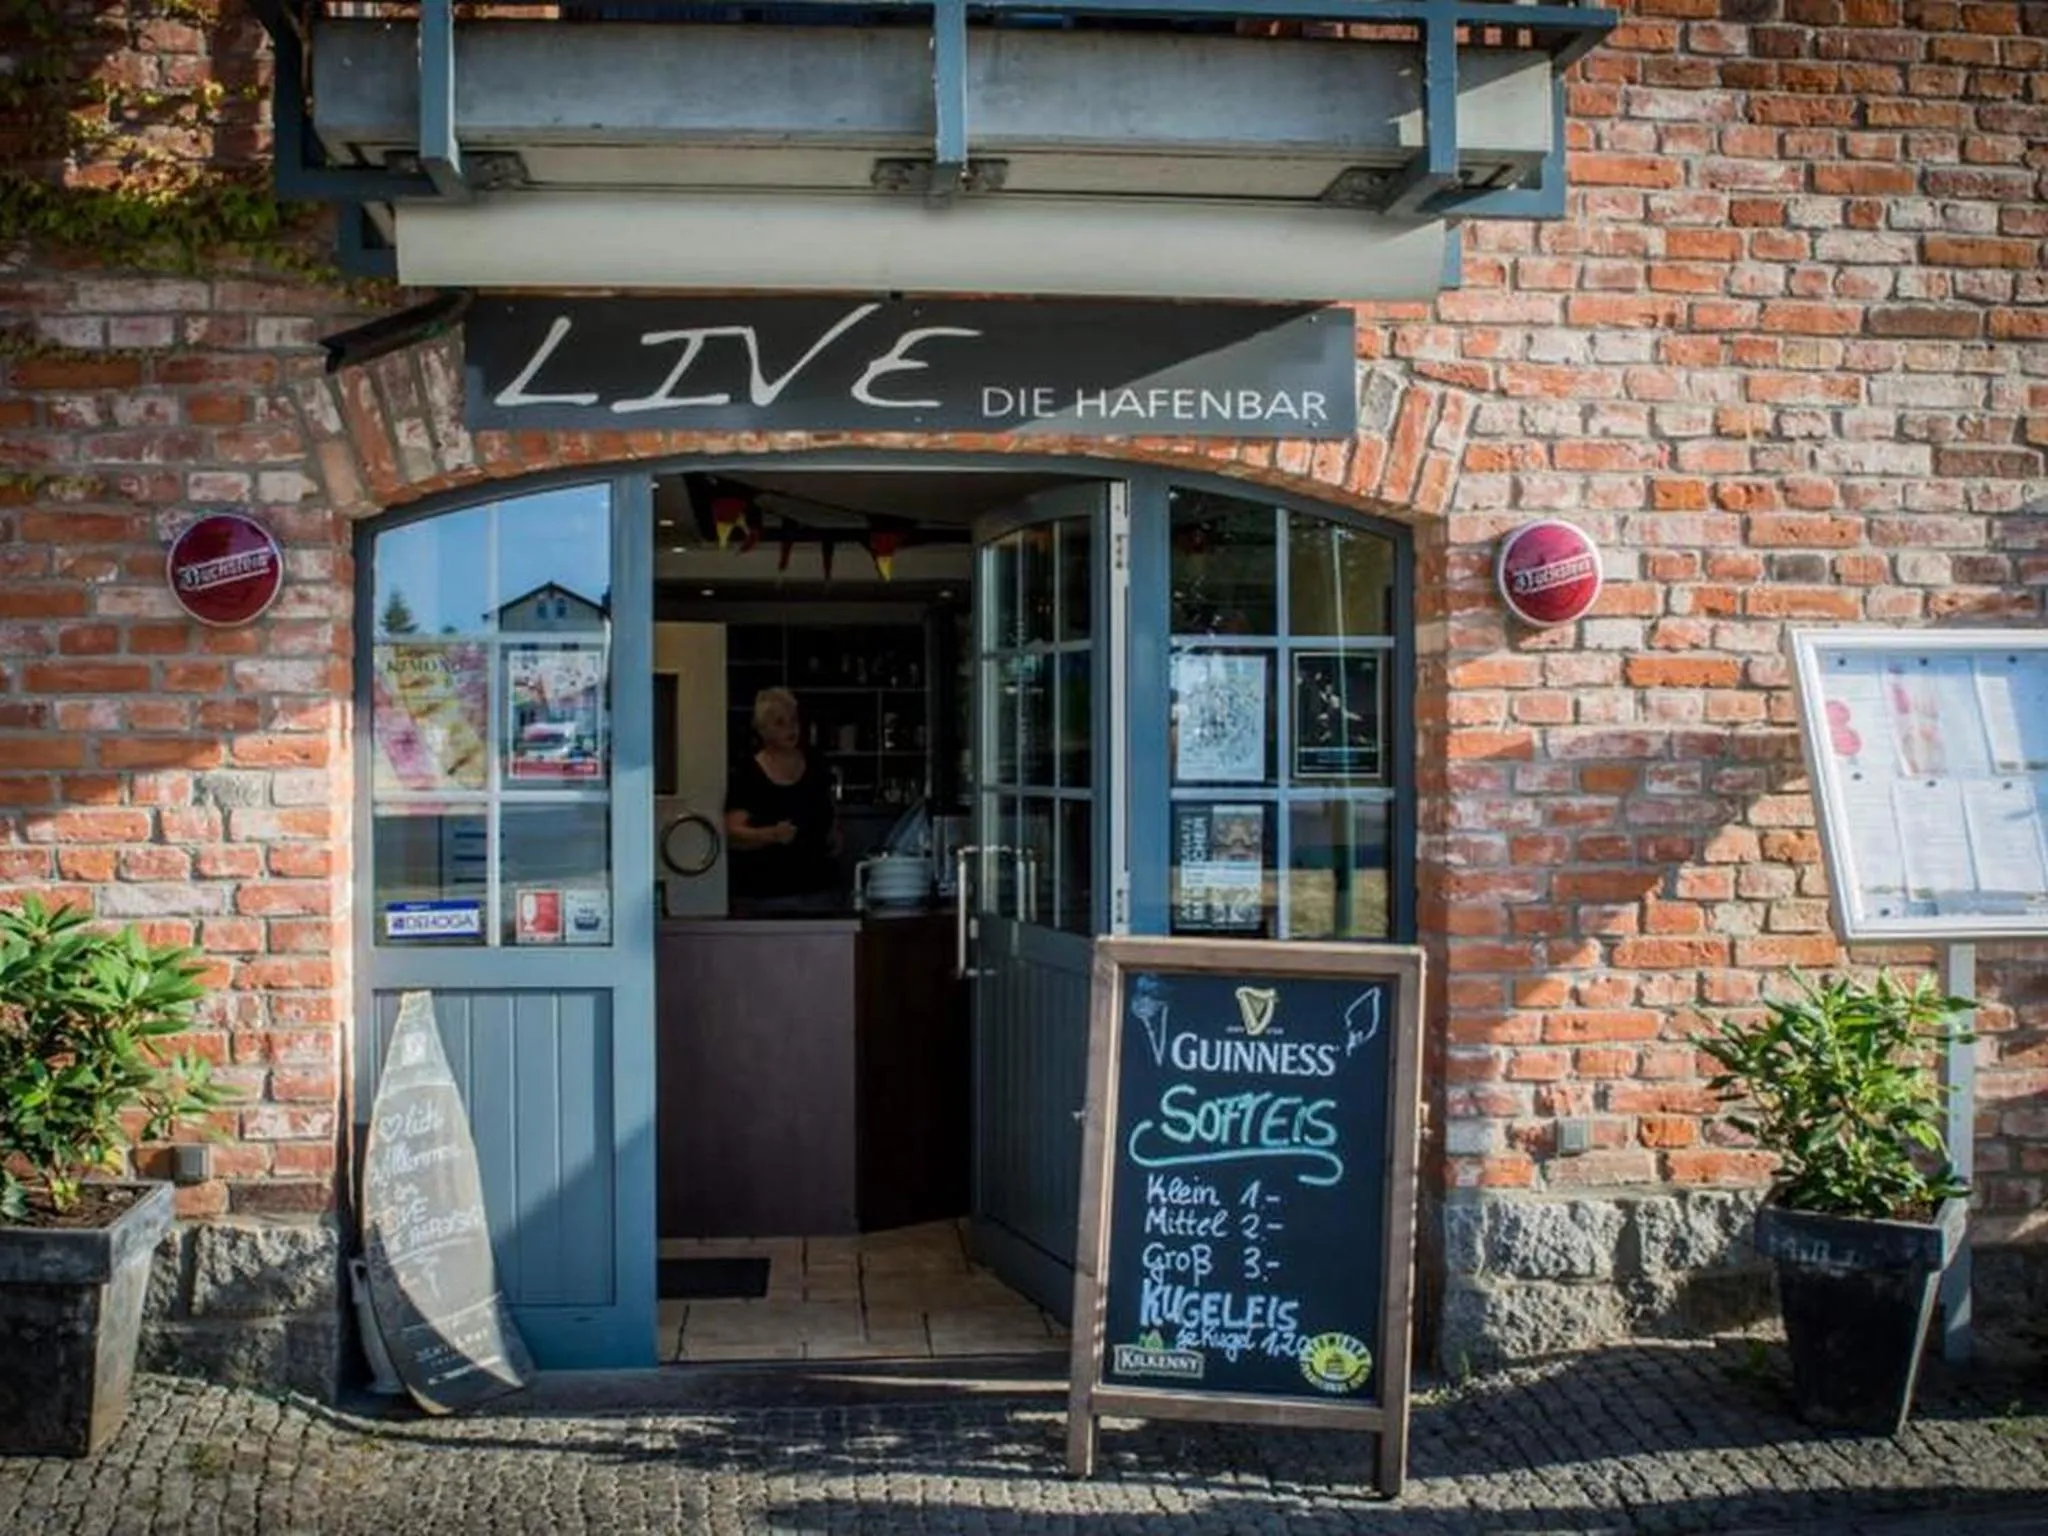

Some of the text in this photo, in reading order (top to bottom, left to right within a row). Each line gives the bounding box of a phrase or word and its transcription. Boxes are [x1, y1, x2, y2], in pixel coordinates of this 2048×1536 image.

[494, 302, 1329, 422] LIVE DIE HAFENBAR
[1171, 1032, 1337, 1077] GUINNESS
[1146, 1174, 1221, 1207] Klein
[1144, 1206, 1229, 1238] Mittel
[1142, 1242, 1213, 1287] Groß
[1119, 1350, 1199, 1373] KILKENNY
